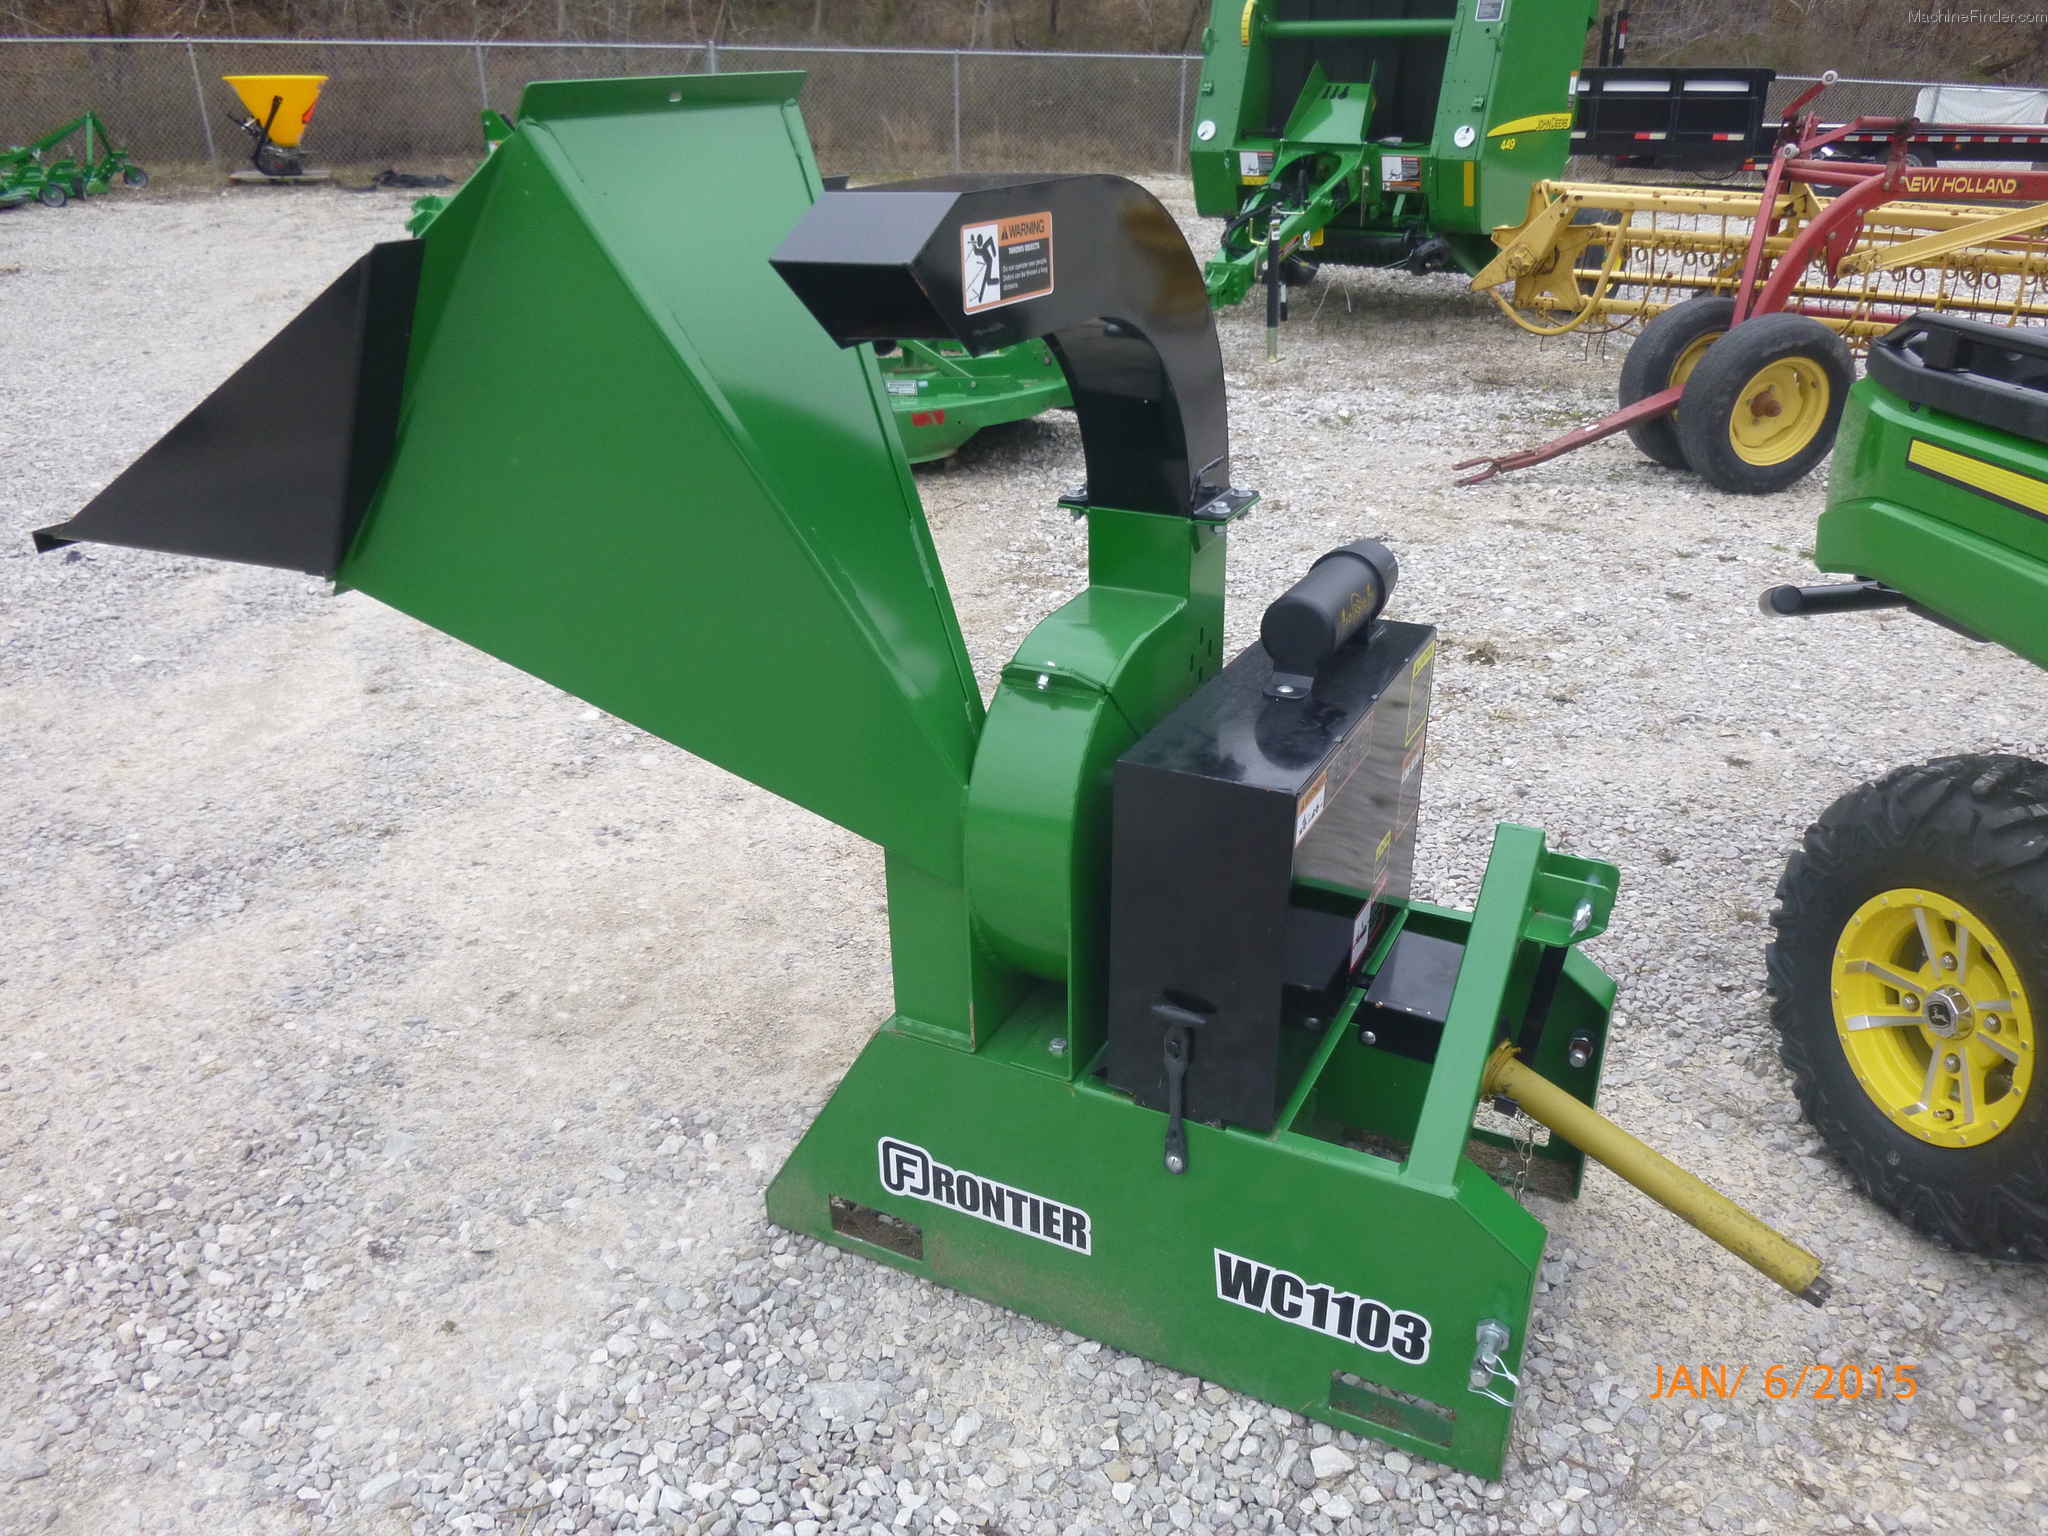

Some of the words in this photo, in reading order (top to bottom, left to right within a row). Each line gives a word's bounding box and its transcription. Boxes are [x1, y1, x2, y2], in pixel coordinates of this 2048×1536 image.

[1535, 118, 1551, 131] JOHN
[1552, 117, 1569, 129] DEERE
[1500, 138, 1516, 151] 449
[1941, 176, 2018, 194] HOLLAND
[1008, 220, 1044, 238] WARNING
[1024, 241, 1040, 252] OBJECTS
[881, 1139, 1088, 1251] FRONTIER
[1217, 1252, 1428, 1361] WC1103
